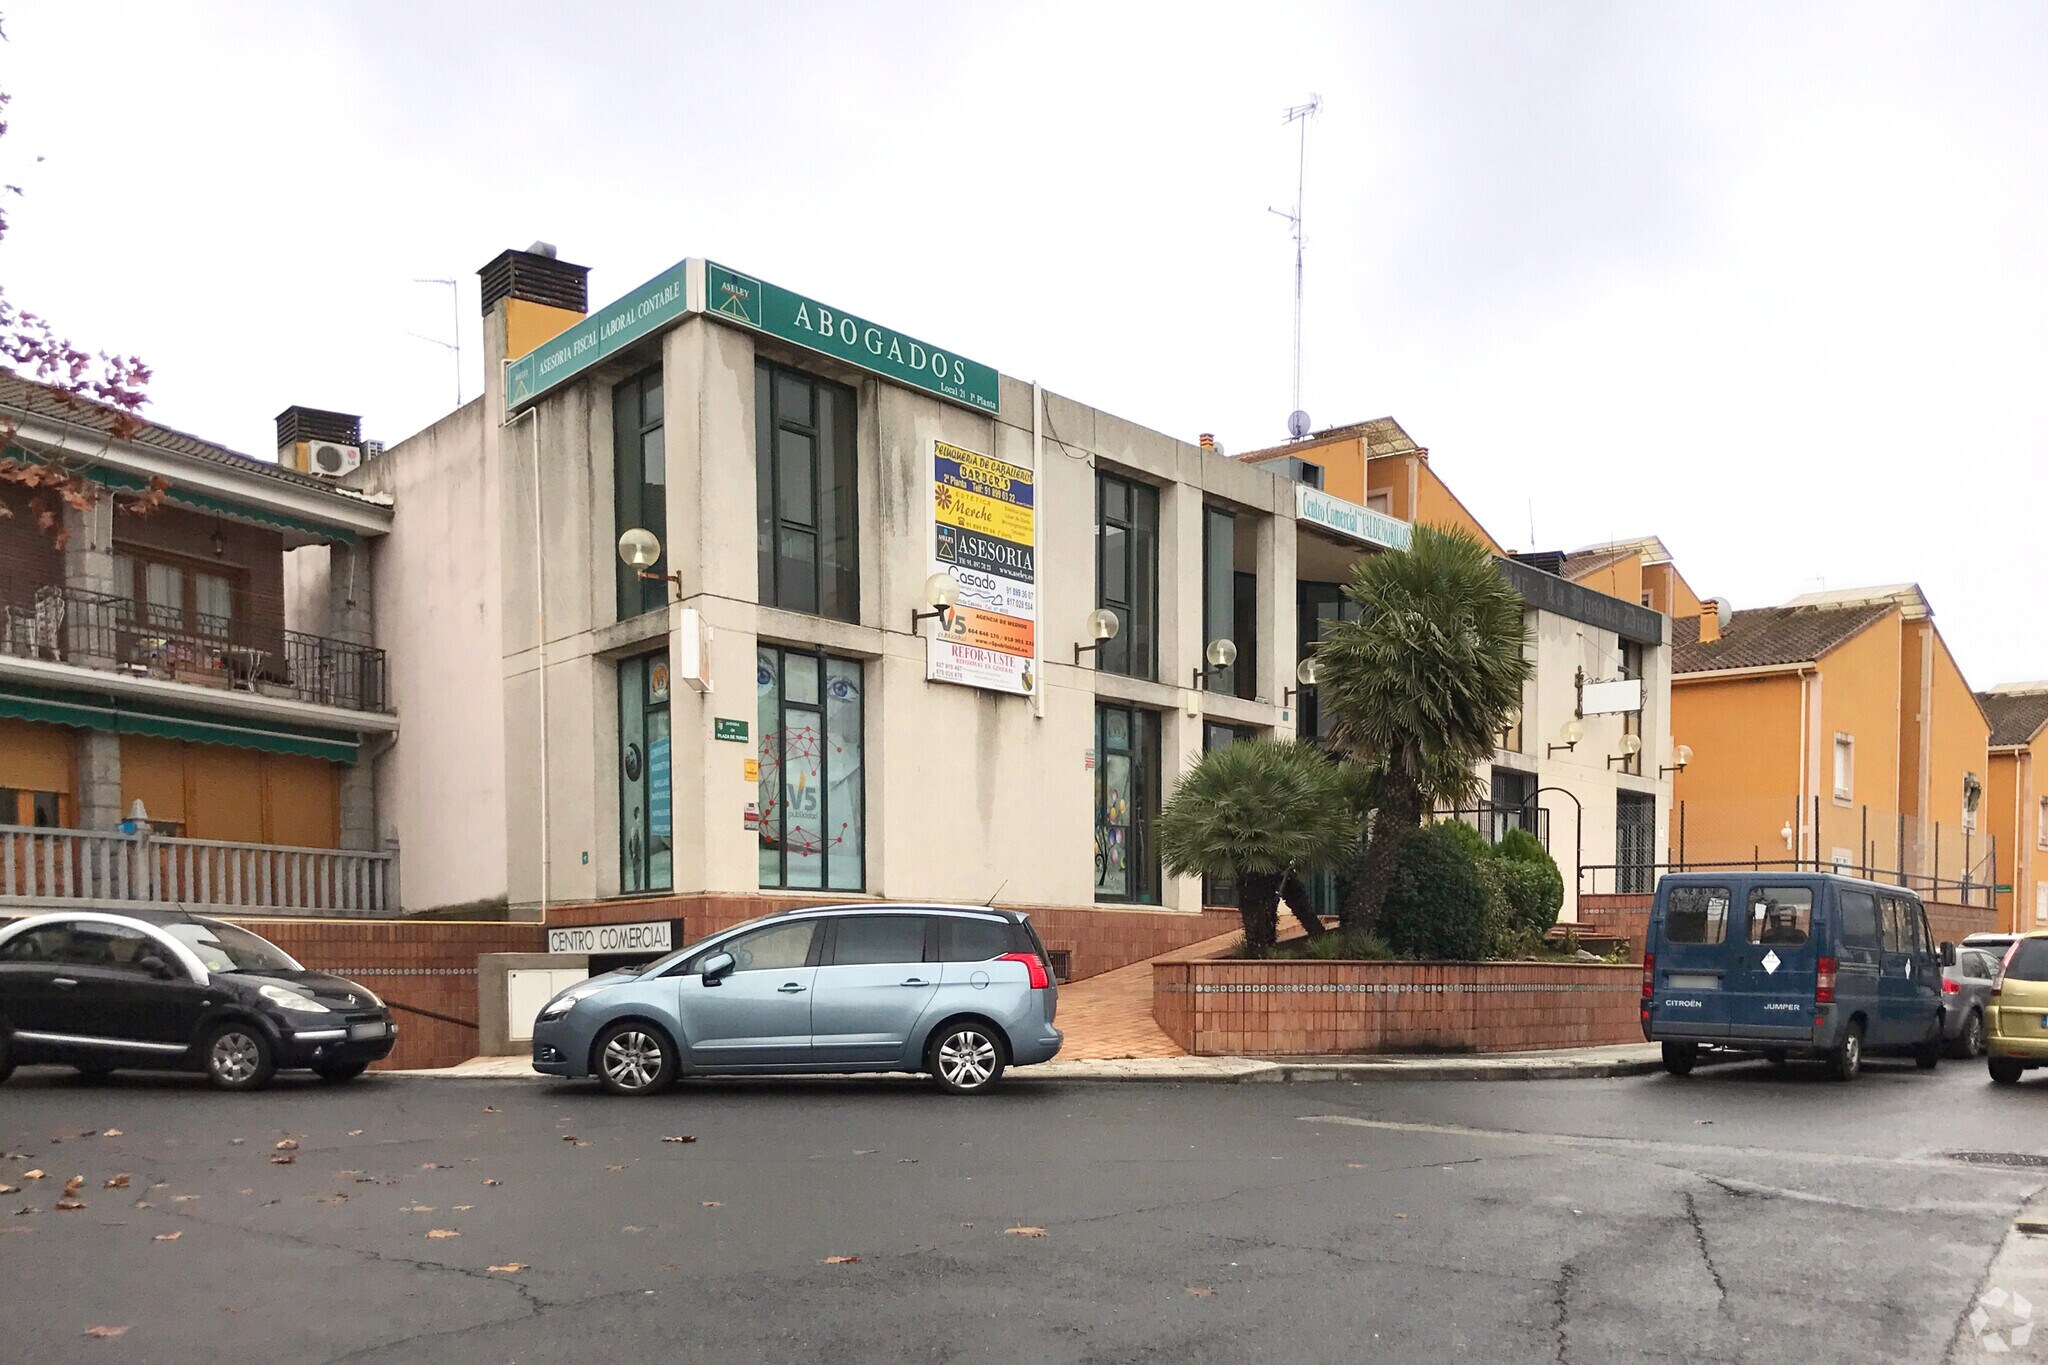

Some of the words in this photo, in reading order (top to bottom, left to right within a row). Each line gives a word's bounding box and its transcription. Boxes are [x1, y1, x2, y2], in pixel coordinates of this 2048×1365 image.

[721, 282, 750, 298] ASELEY
[539, 347, 572, 376] ASESORIA
[573, 330, 598, 357] FISCAL
[600, 308, 636, 340] LABORAL
[637, 281, 680, 319] CONTABLE
[794, 302, 965, 385] ABOGADOS
[940, 382, 958, 396] Local
[976, 394, 996, 409] Planta
[950, 476, 967, 489] Planta
[984, 486, 991, 496] 91
[1008, 493, 1015, 503] 22
[961, 466, 1009, 490] BARBER'S
[949, 499, 992, 522] Merche
[1303, 492, 1325, 522] Centro
[1326, 500, 1358, 533] Comercial
[958, 535, 1033, 571] ASESORIA
[948, 565, 996, 590] Casado
[1006, 586, 1012, 594] 91
[1012, 587, 1021, 597] 899
[941, 607, 966, 634] V5
[976, 614, 998, 624] AGENCIA
[1007, 620, 1027, 630] MEDIOS
[952, 645, 1015, 668] REFOR-YUSTE
[956, 658, 983, 669] REFORMAS
[985, 661, 991, 669] EN
[992, 664, 1014, 674] GENERAL
[788, 770, 816, 811] V5
[551, 930, 595, 952] CENTRO
[600, 925, 669, 950] COMERCIAL
[1665, 999, 1702, 1008] CITROËN
[1763, 1002, 1800, 1011] JUMPER
